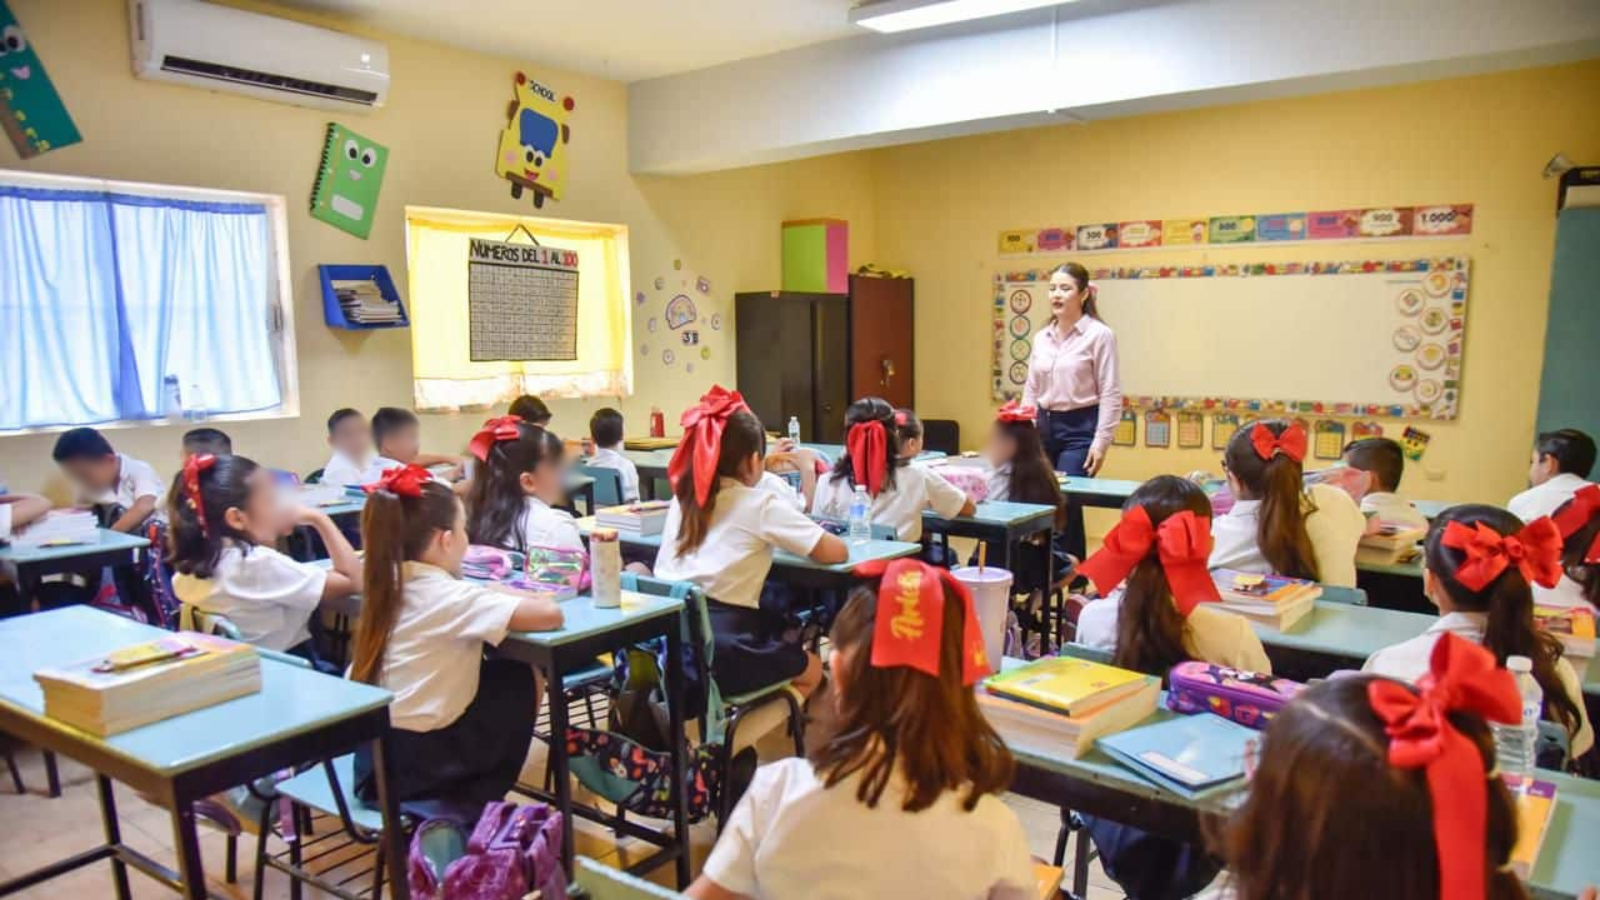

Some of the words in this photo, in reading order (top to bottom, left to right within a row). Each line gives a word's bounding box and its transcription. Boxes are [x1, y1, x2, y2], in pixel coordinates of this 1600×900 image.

[522, 247, 540, 263] DEL
[541, 248, 549, 265] 1
[551, 250, 561, 265] AL
